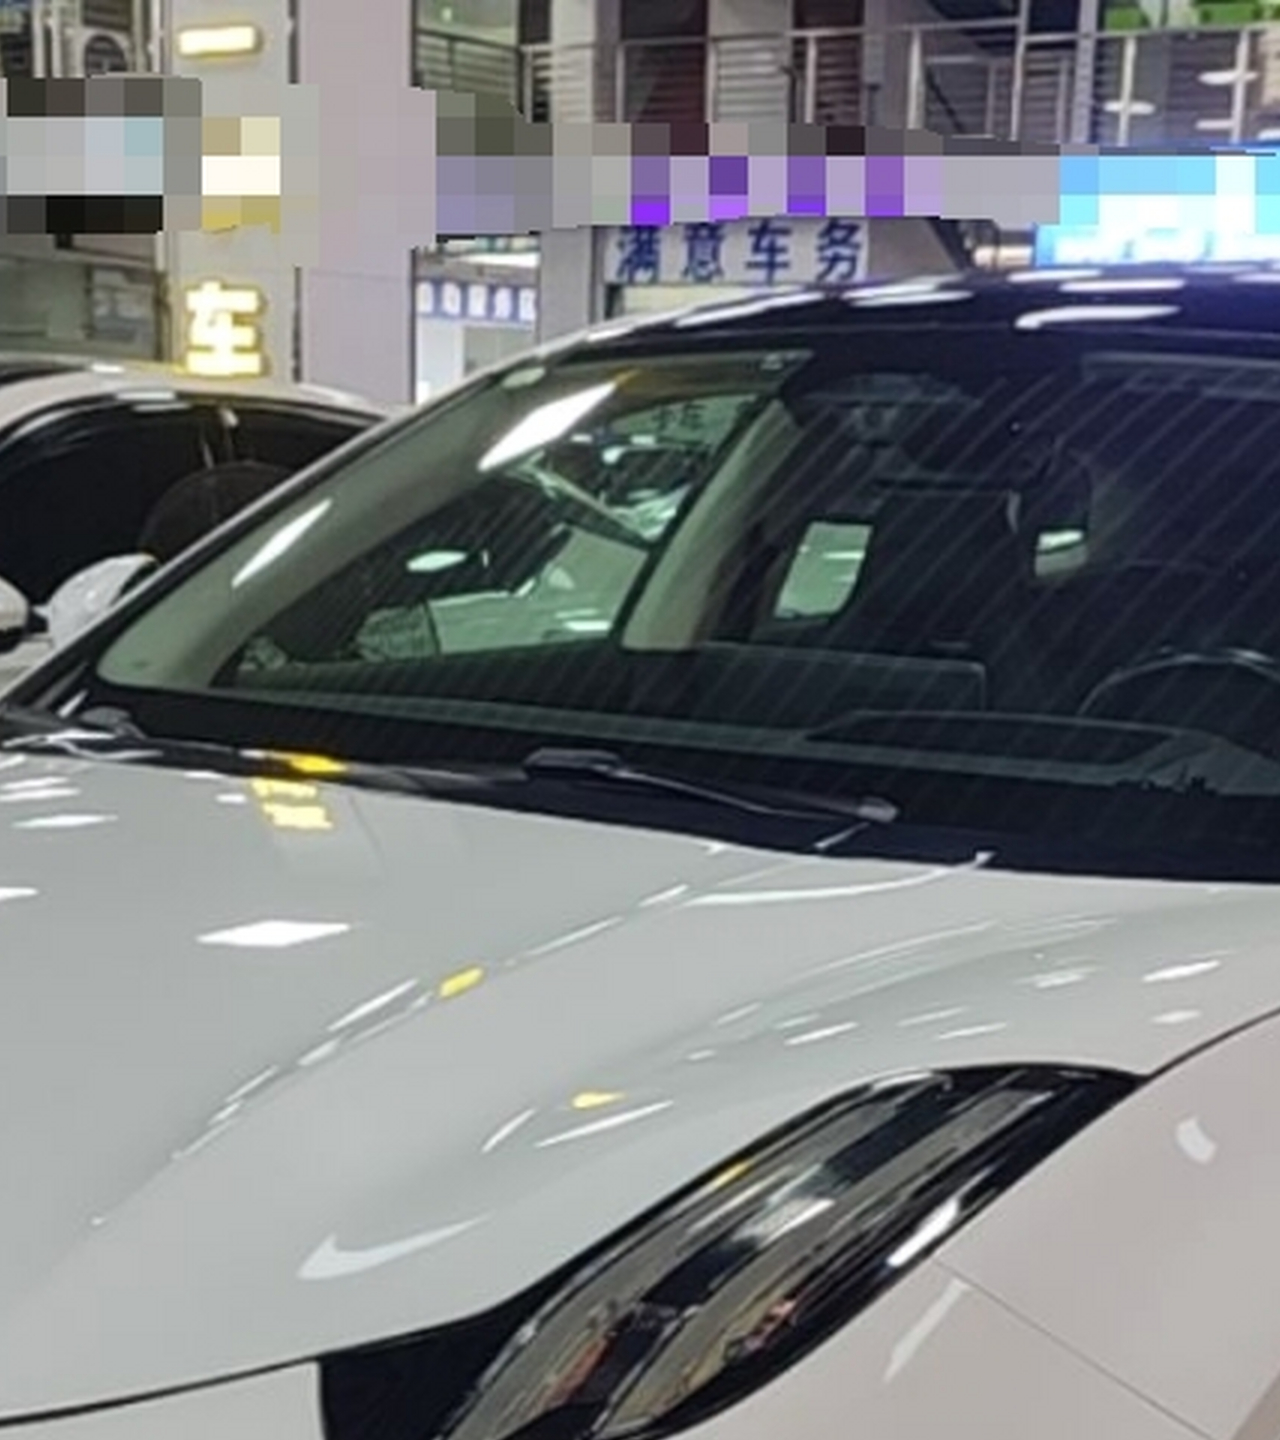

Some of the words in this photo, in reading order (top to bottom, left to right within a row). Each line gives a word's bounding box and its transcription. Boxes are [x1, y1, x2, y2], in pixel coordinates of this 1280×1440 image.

[616, 217, 862, 284] 满意车务
[186, 281, 261, 375] 车
